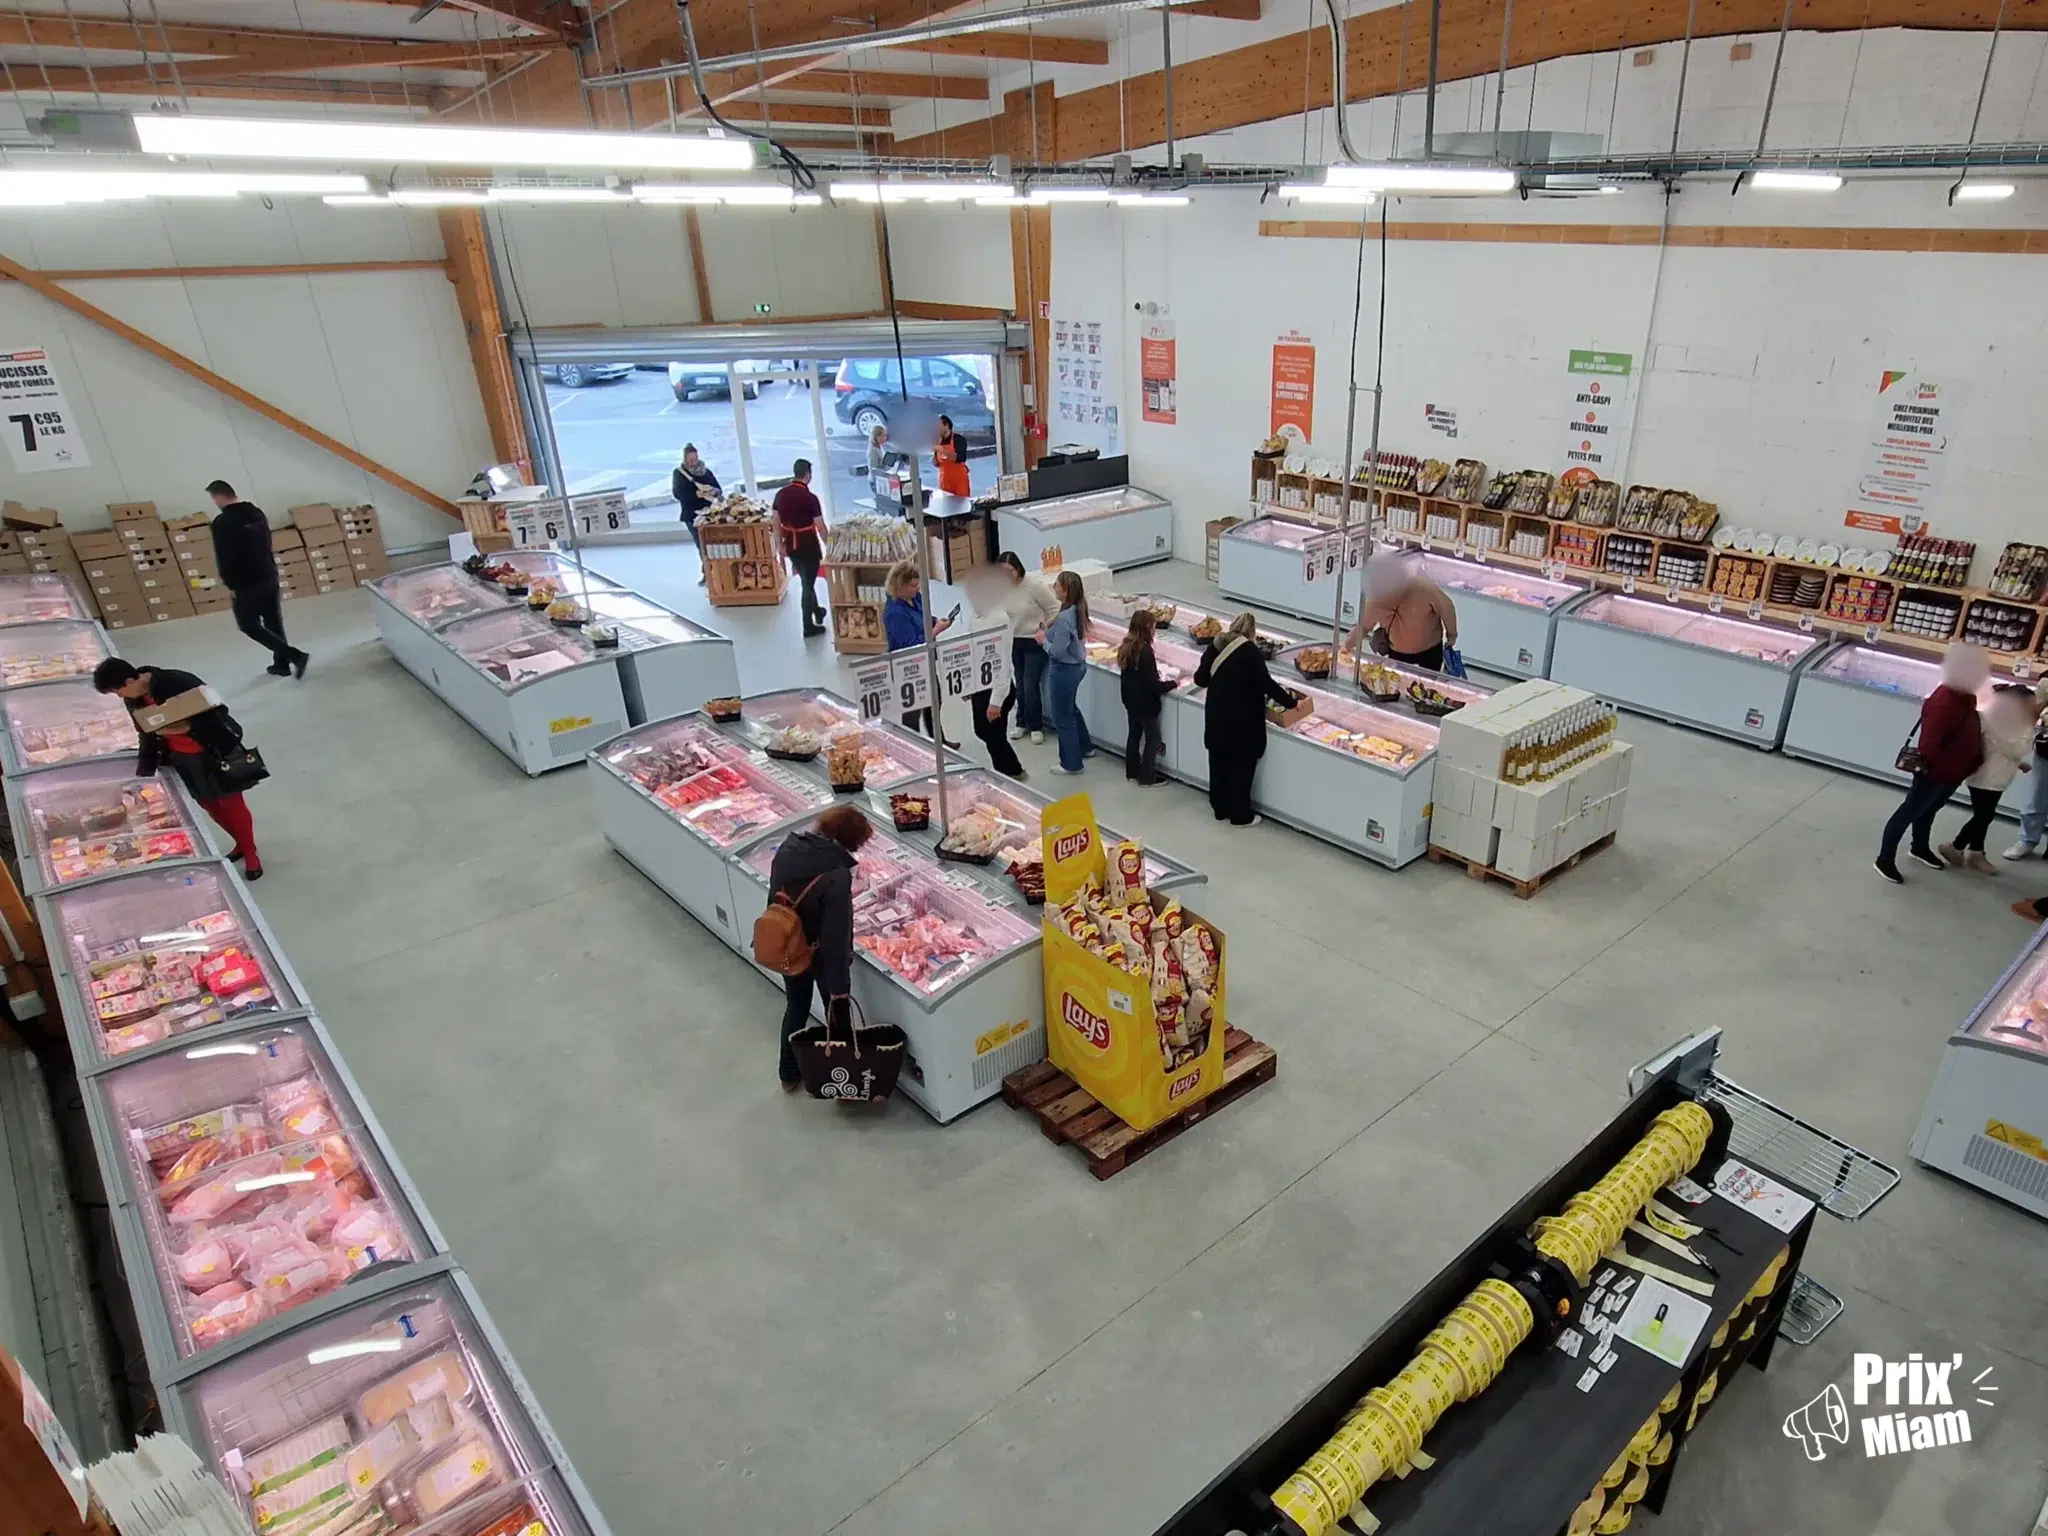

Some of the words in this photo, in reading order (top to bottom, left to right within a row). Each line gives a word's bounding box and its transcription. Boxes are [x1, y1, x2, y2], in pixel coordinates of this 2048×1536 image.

[1576, 394, 1611, 406] ANTI-GASPI
[1887, 423, 1918, 434] MEILLEURS
[1894, 414, 1921, 424] PROFITEZ
[1922, 417, 1934, 425] DES
[8, 414, 37, 452] 7
[40, 428, 50, 436] LE
[52, 426, 66, 434] KG
[1568, 450, 1586, 462] PETITS
[1588, 453, 1602, 463] PRIX
[582, 517, 590, 533] 7
[608, 512, 618, 529] 8
[517, 526, 526, 544] 7
[546, 522, 558, 540] 6
[1326, 556, 1334, 574] 9
[1350, 549, 1357, 568] 6
[1306, 562, 1314, 581] 6
[980, 661, 992, 686] 8
[946, 670, 962, 696] 13
[901, 682, 915, 708] 9
[860, 692, 880, 719] 10
[1056, 829, 1089, 860] Lay's
[1064, 994, 1110, 1042] Lay's
[1171, 1068, 1200, 1099] Lay's
